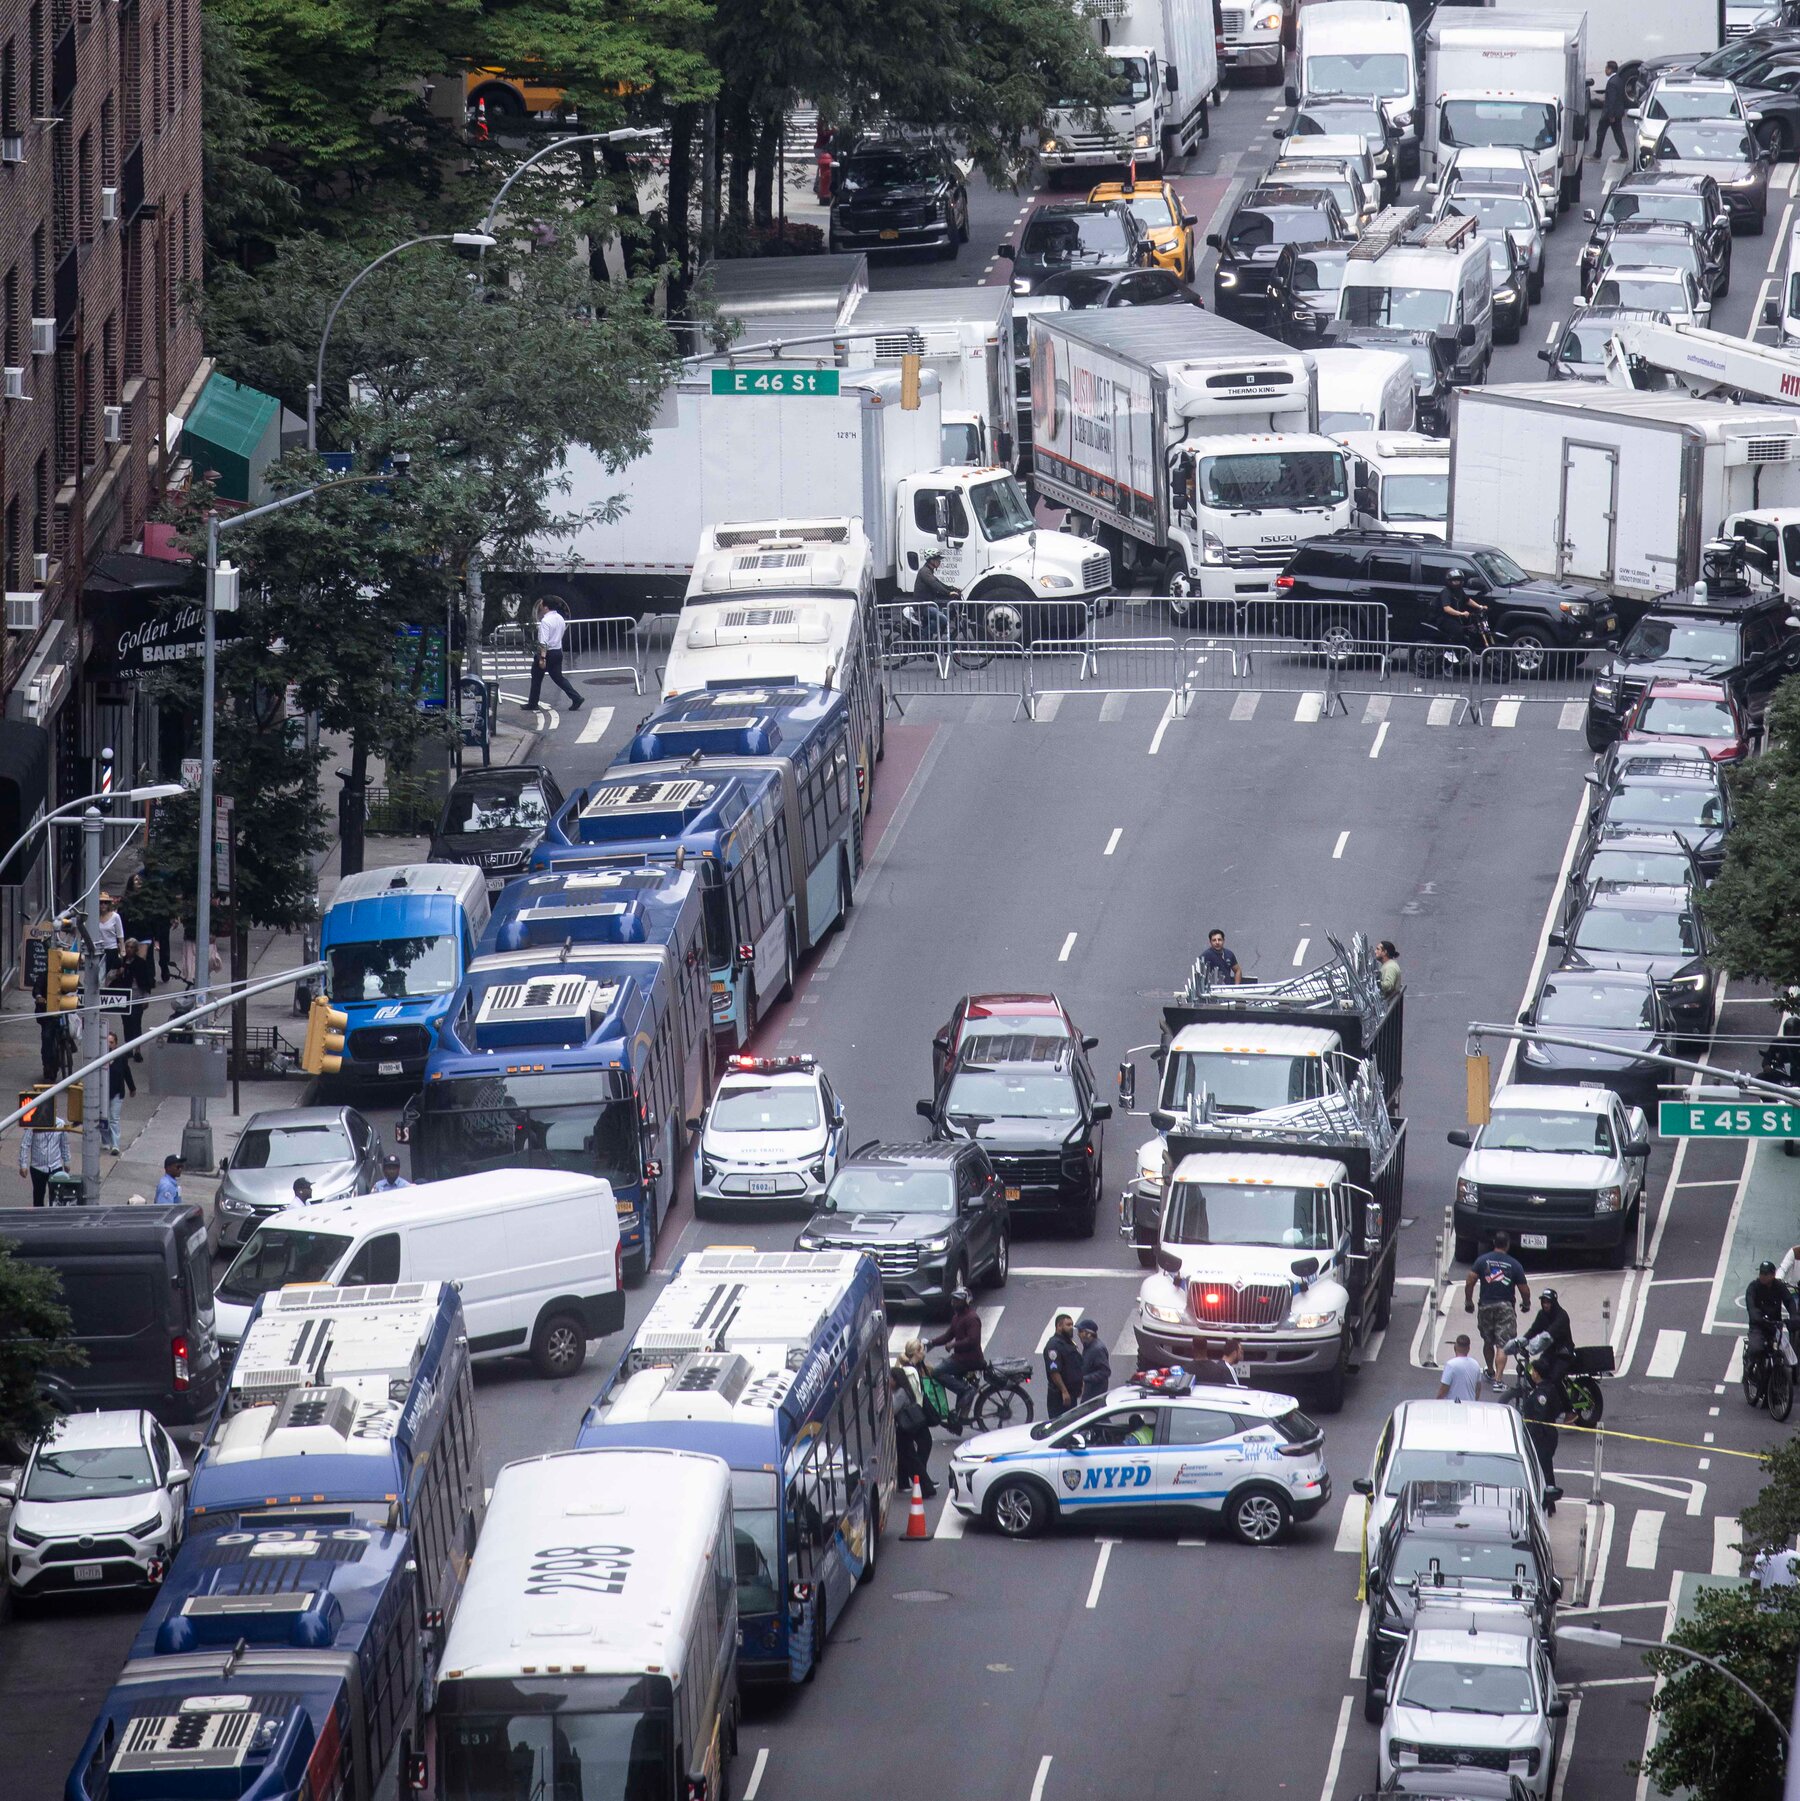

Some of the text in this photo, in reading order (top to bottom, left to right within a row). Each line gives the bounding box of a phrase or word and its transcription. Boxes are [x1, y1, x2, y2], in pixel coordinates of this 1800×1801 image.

[735, 374, 816, 391] E 46 St
[1260, 534, 1297, 543] ISUZU
[118, 618, 169, 660] Golden
[119, 669, 134, 679] 853
[101, 996, 123, 1006] WAY
[1690, 1109, 1792, 1132] E 45 St
[751, 1183, 768, 1191] 7602
[1083, 1465, 1152, 1490] NYPD
[524, 1545, 635, 1595] 2298
